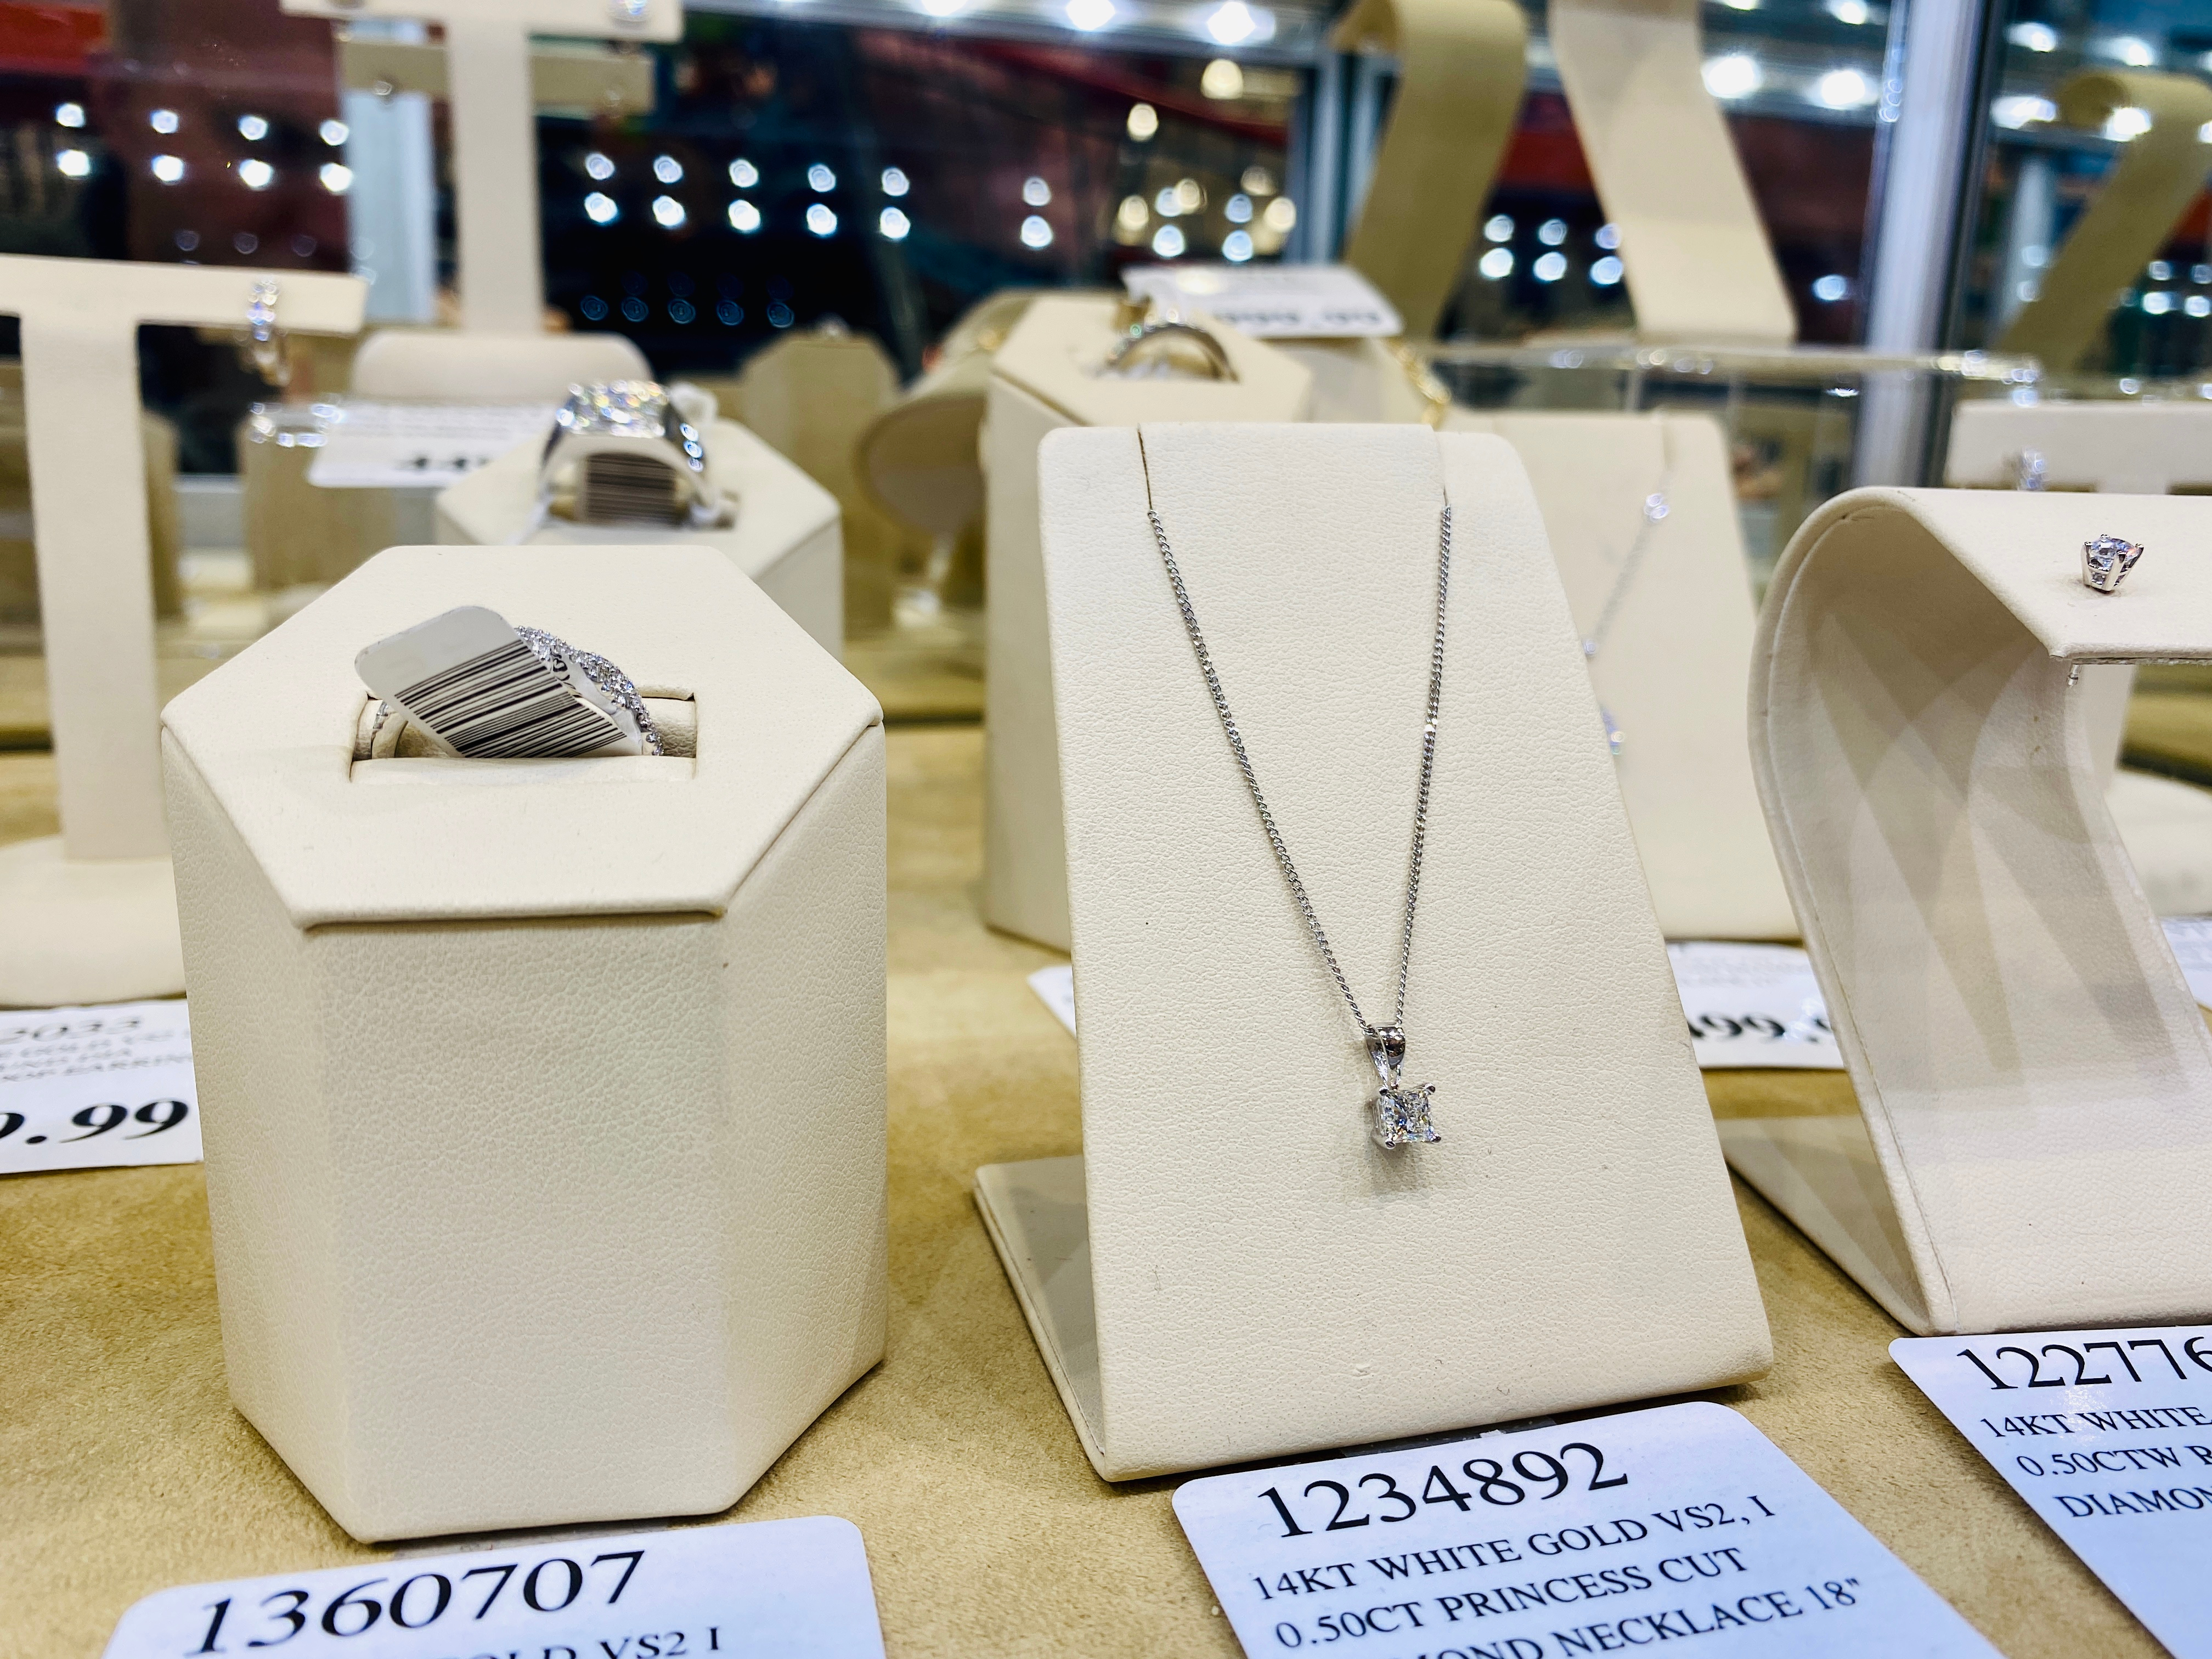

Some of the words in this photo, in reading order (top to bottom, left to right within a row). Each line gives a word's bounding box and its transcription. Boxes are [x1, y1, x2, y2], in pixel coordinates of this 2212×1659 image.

[1980, 1414, 2076, 1437] 14KT
[2076, 1407, 2212, 1431] WHITE
[2016, 1447, 2182, 1476] 0.50CTW
[1258, 1442, 1628, 1537] 1234892
[1253, 1562, 1357, 1600] 14KT
[1367, 1539, 1522, 1580] WHITE
[1528, 1519, 1648, 1555] GOLD
[1651, 1503, 1750, 1532] VS2,
[1747, 1495, 1776, 1517] I
[183, 1550, 645, 1656] 1360707
[1276, 1601, 1425, 1648] 0.50CT
[1435, 1566, 1652, 1622] PRINCESS
[1658, 1547, 1747, 1583] CUT
[1550, 1591, 1803, 1657] NECKLACE
[1804, 1578, 1861, 1610] 18"
[600, 1631, 687, 1659] VS2
[708, 1627, 721, 1651] I
